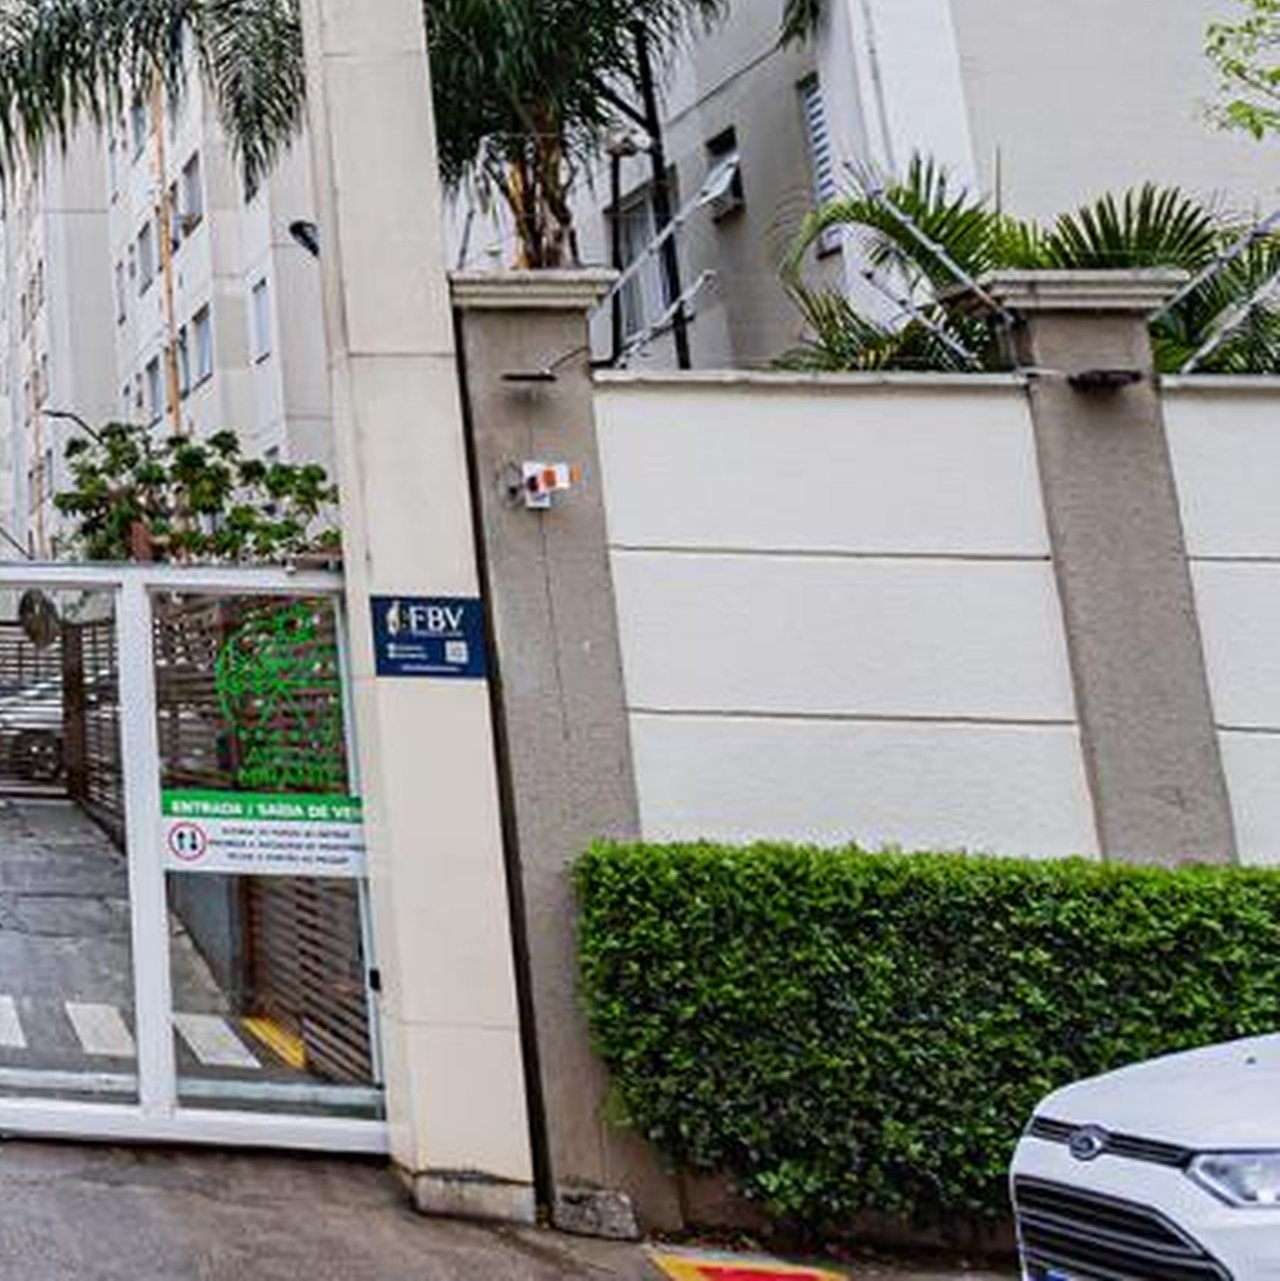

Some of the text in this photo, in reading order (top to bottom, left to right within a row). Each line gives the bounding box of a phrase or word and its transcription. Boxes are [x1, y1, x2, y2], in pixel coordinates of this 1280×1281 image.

[409, 606, 464, 631] FBV
[171, 800, 243, 815] ENTRADA
[308, 804, 331, 818] DE
